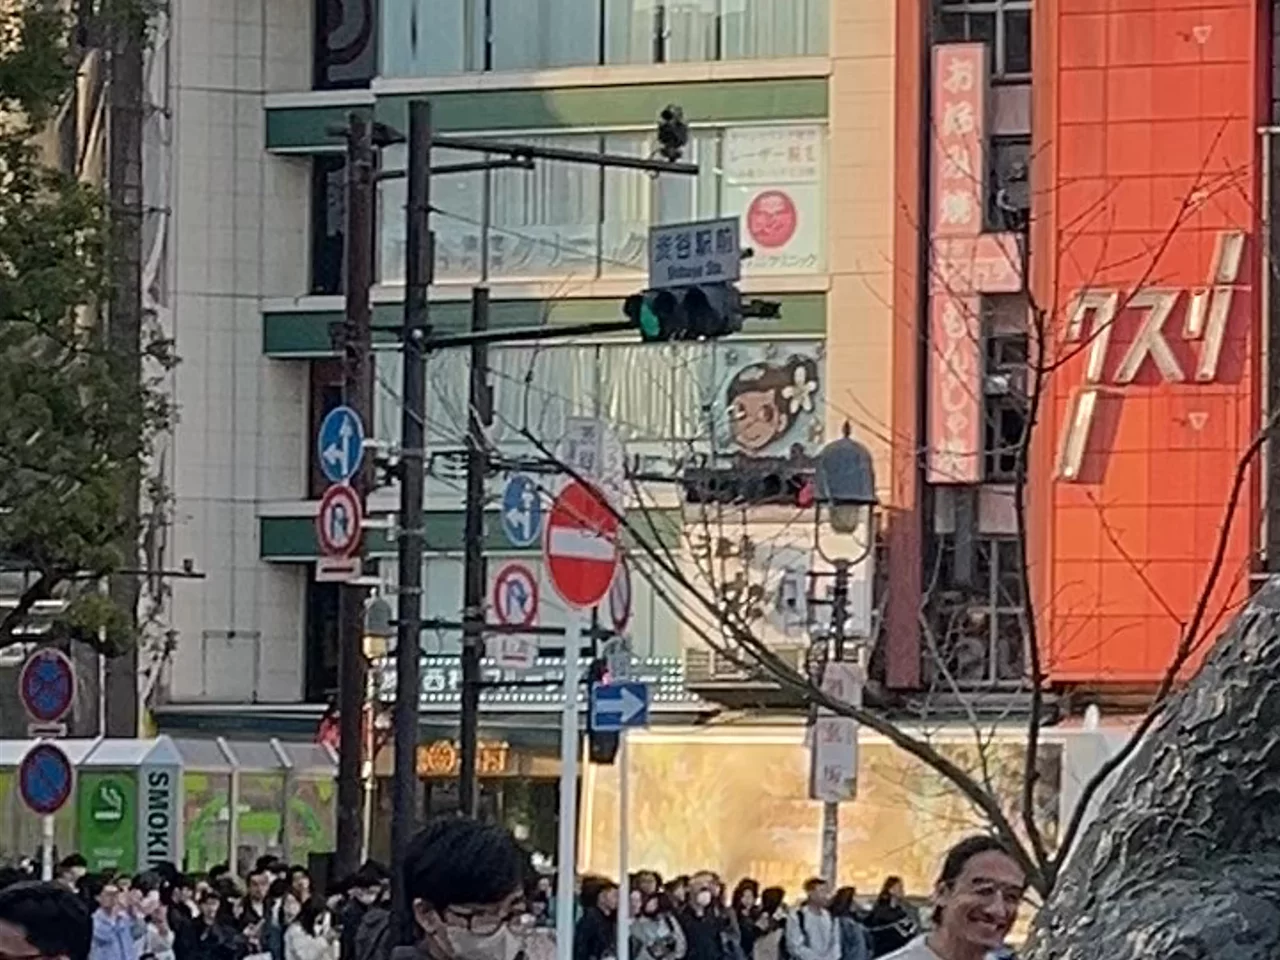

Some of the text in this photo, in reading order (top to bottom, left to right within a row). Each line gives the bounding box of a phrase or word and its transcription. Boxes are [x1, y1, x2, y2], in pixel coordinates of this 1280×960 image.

[655, 226, 734, 262] 渋谷駅前
[1054, 229, 1246, 481] クスリ
